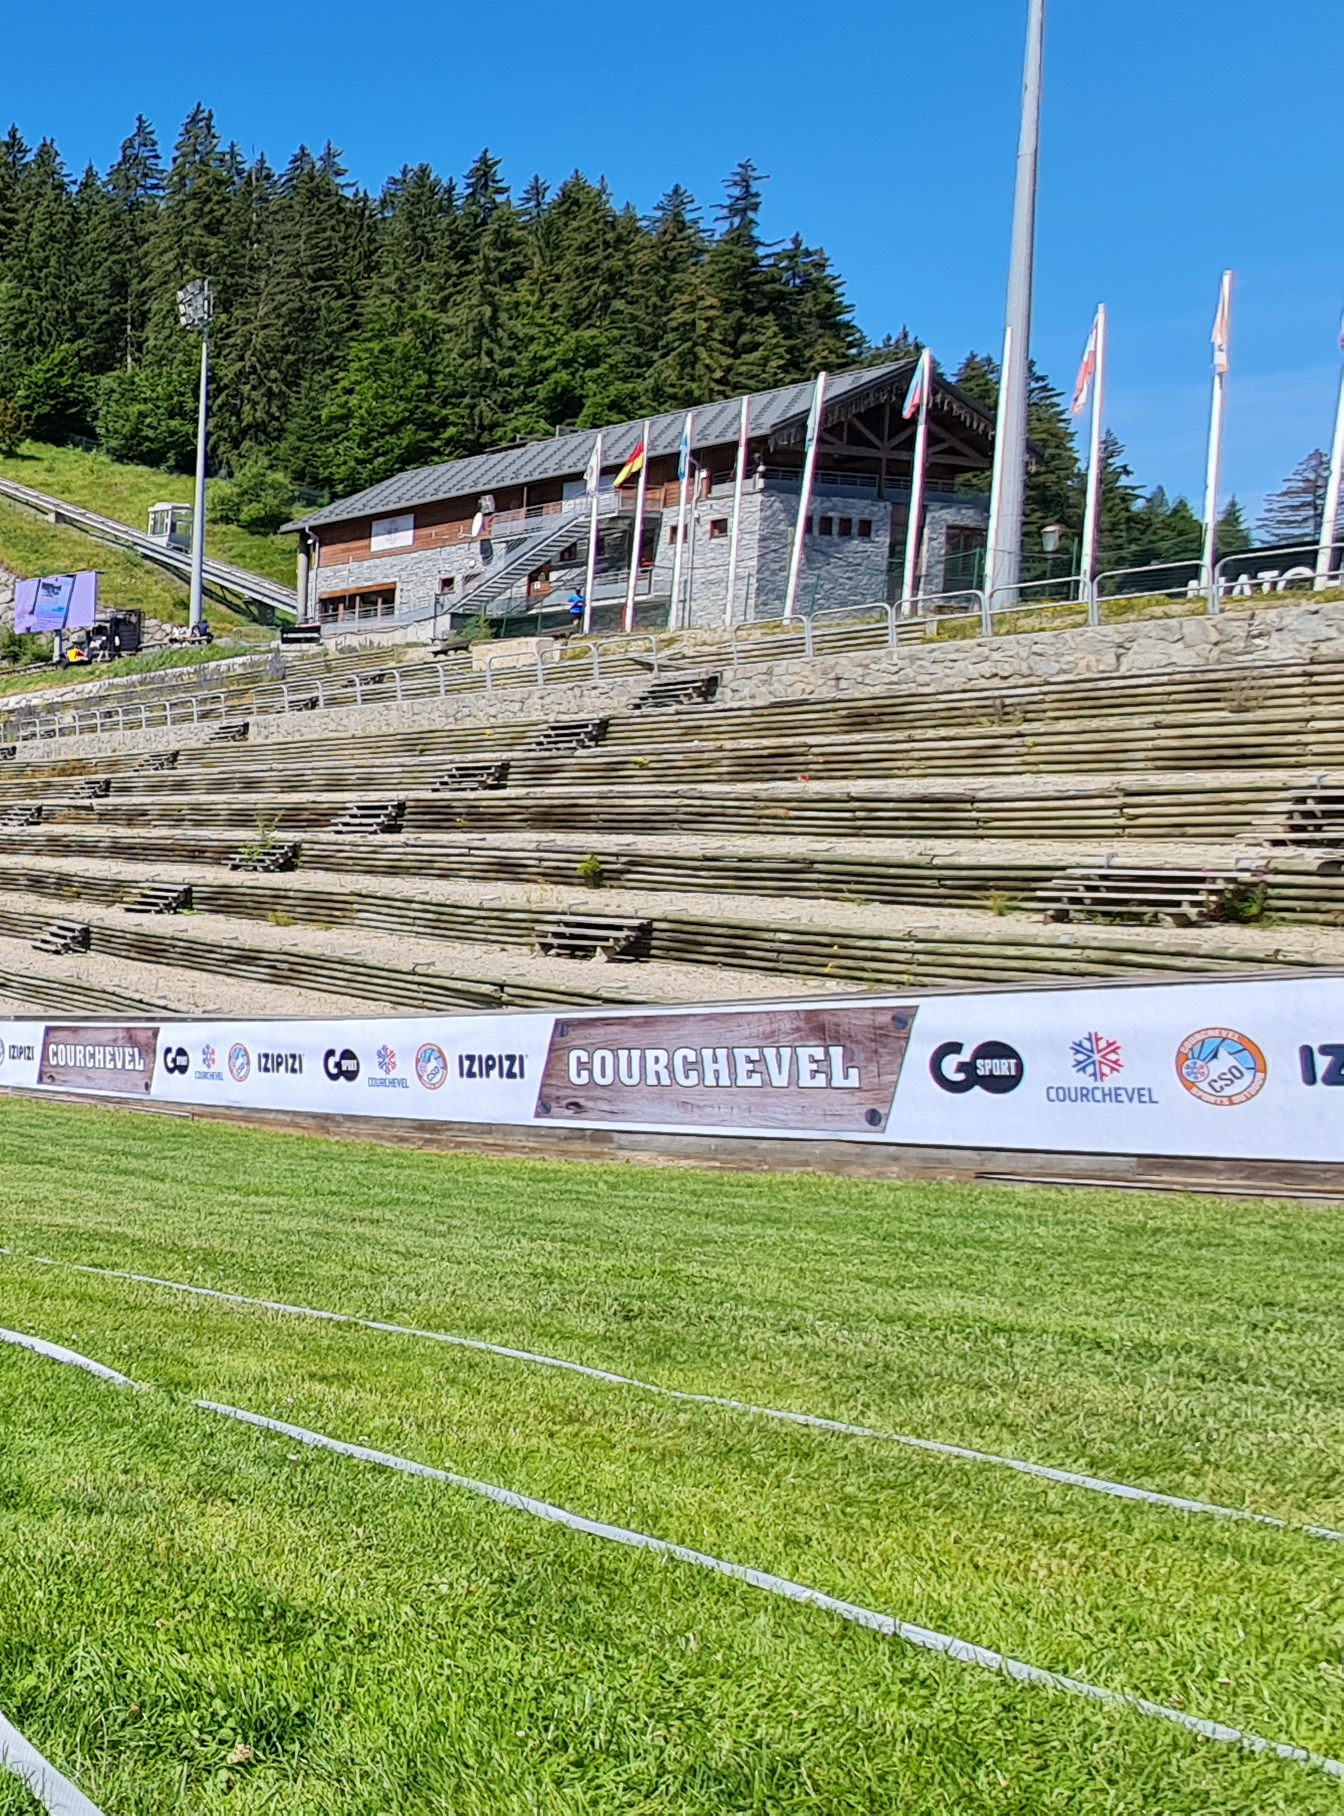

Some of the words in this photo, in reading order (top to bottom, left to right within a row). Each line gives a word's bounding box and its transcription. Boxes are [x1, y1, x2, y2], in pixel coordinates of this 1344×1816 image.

[48, 1043, 145, 1071] COURCHEVEL
[257, 1052, 303, 1074] IZIPIZI
[458, 1053, 525, 1080] IZIPIZI
[568, 1045, 861, 1089] COURCHEVEL
[976, 1059, 1018, 1076] SPORT
[1207, 1064, 1245, 1094] CSO
[1046, 1086, 1159, 1104] COURCHEVEL
